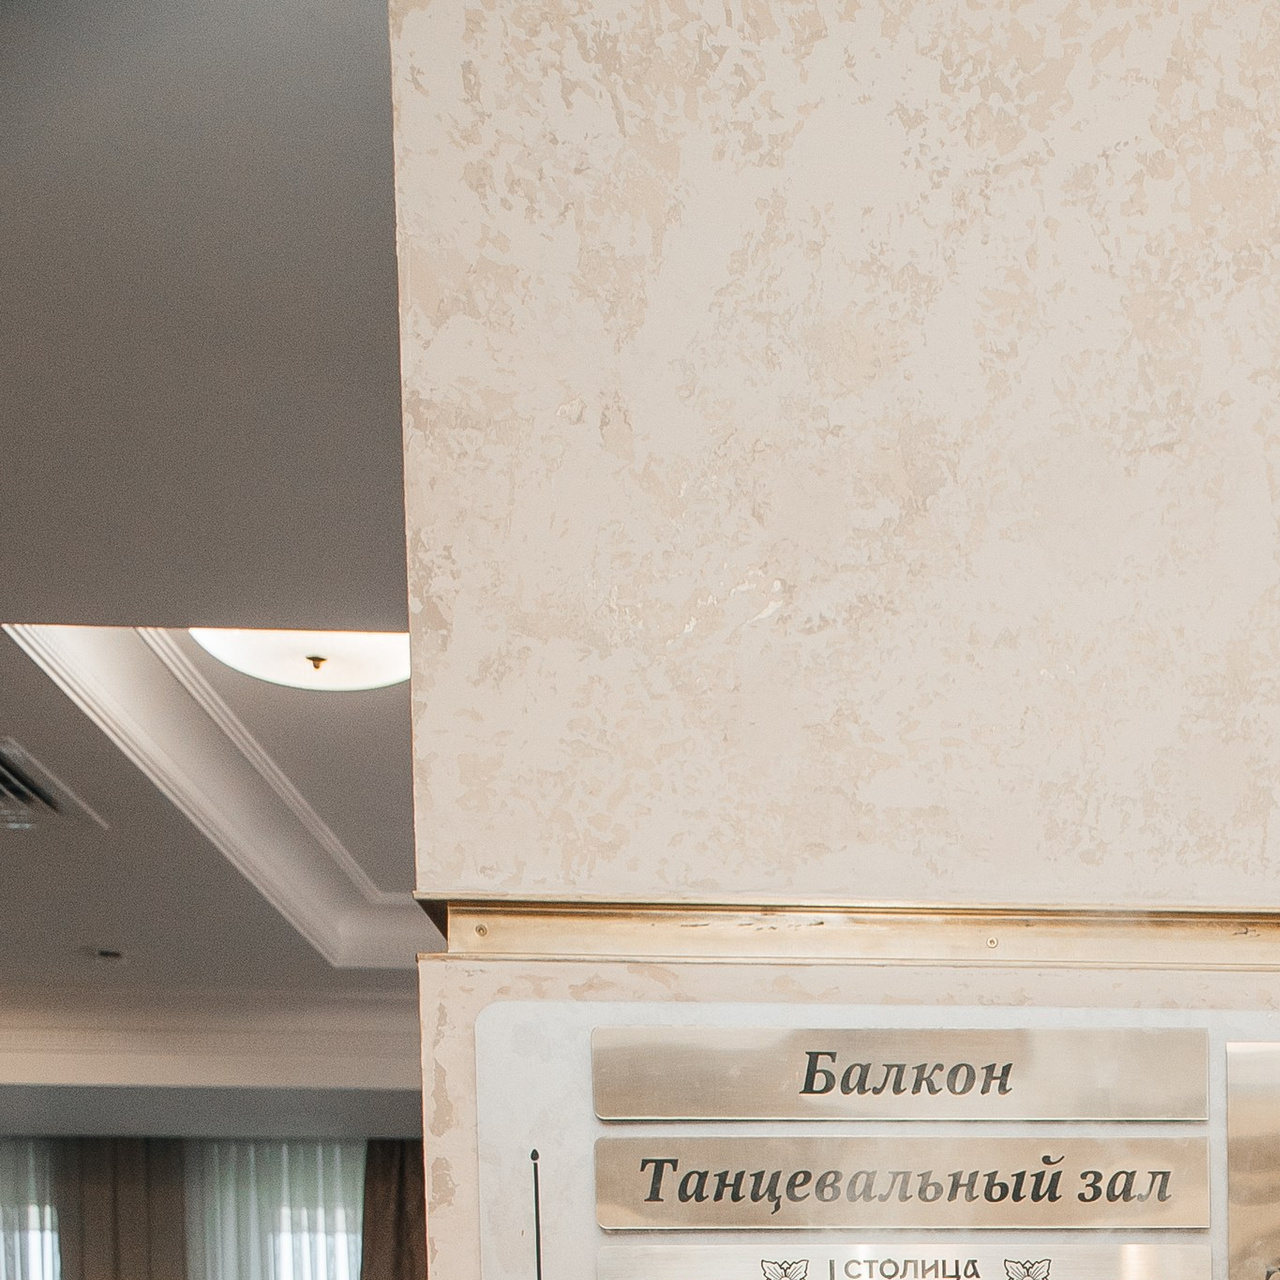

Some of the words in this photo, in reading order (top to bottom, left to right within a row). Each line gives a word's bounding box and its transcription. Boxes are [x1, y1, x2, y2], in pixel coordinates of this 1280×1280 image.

[799, 1051, 1013, 1095] Балкон
[639, 1155, 1065, 1214] Танцевальный
[1077, 1169, 1172, 1203] зал
